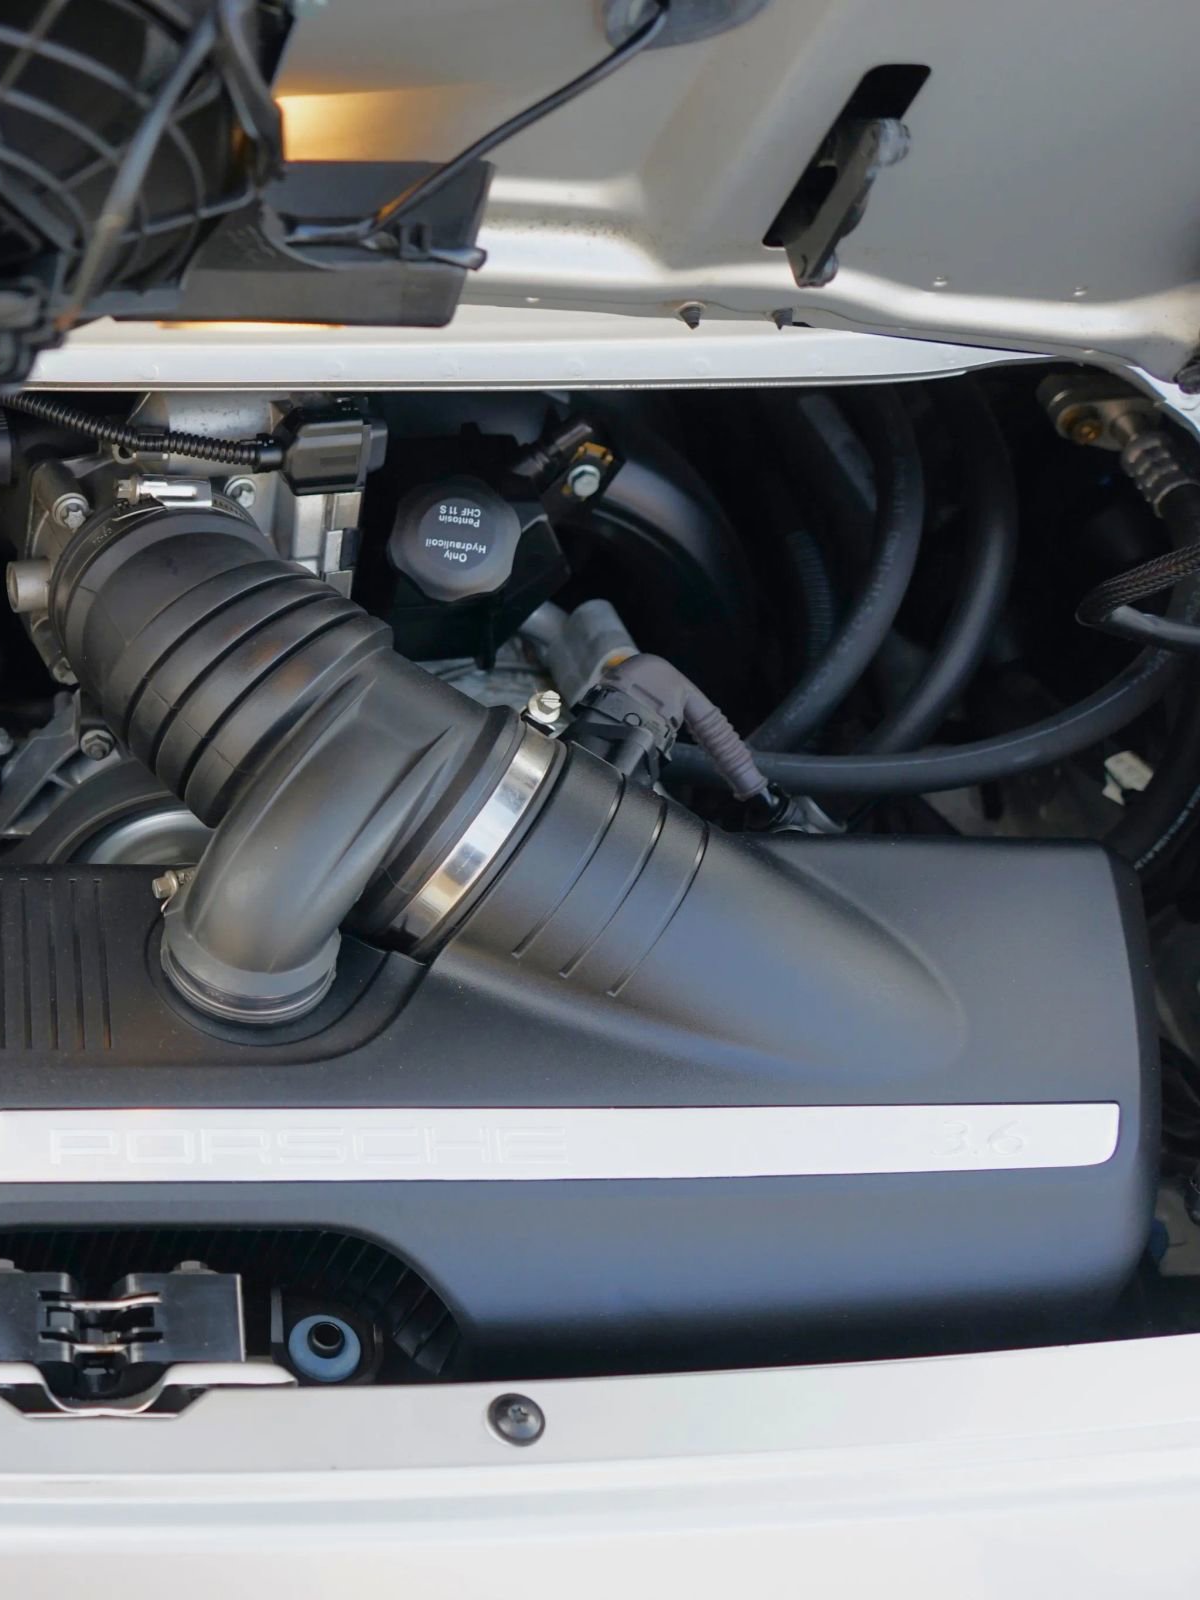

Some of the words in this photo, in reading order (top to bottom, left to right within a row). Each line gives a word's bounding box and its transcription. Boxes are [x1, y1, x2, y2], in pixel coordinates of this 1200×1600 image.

[439, 504, 448, 514] S
[449, 506, 458, 515] 11
[461, 507, 481, 518] CHF
[439, 514, 480, 528] Pentosin
[425, 538, 487, 554] Hydraulicoil
[444, 549, 467, 563] Only
[931, 1119, 1024, 1157] 3.6
[48, 1126, 569, 1166] PORSCHE
